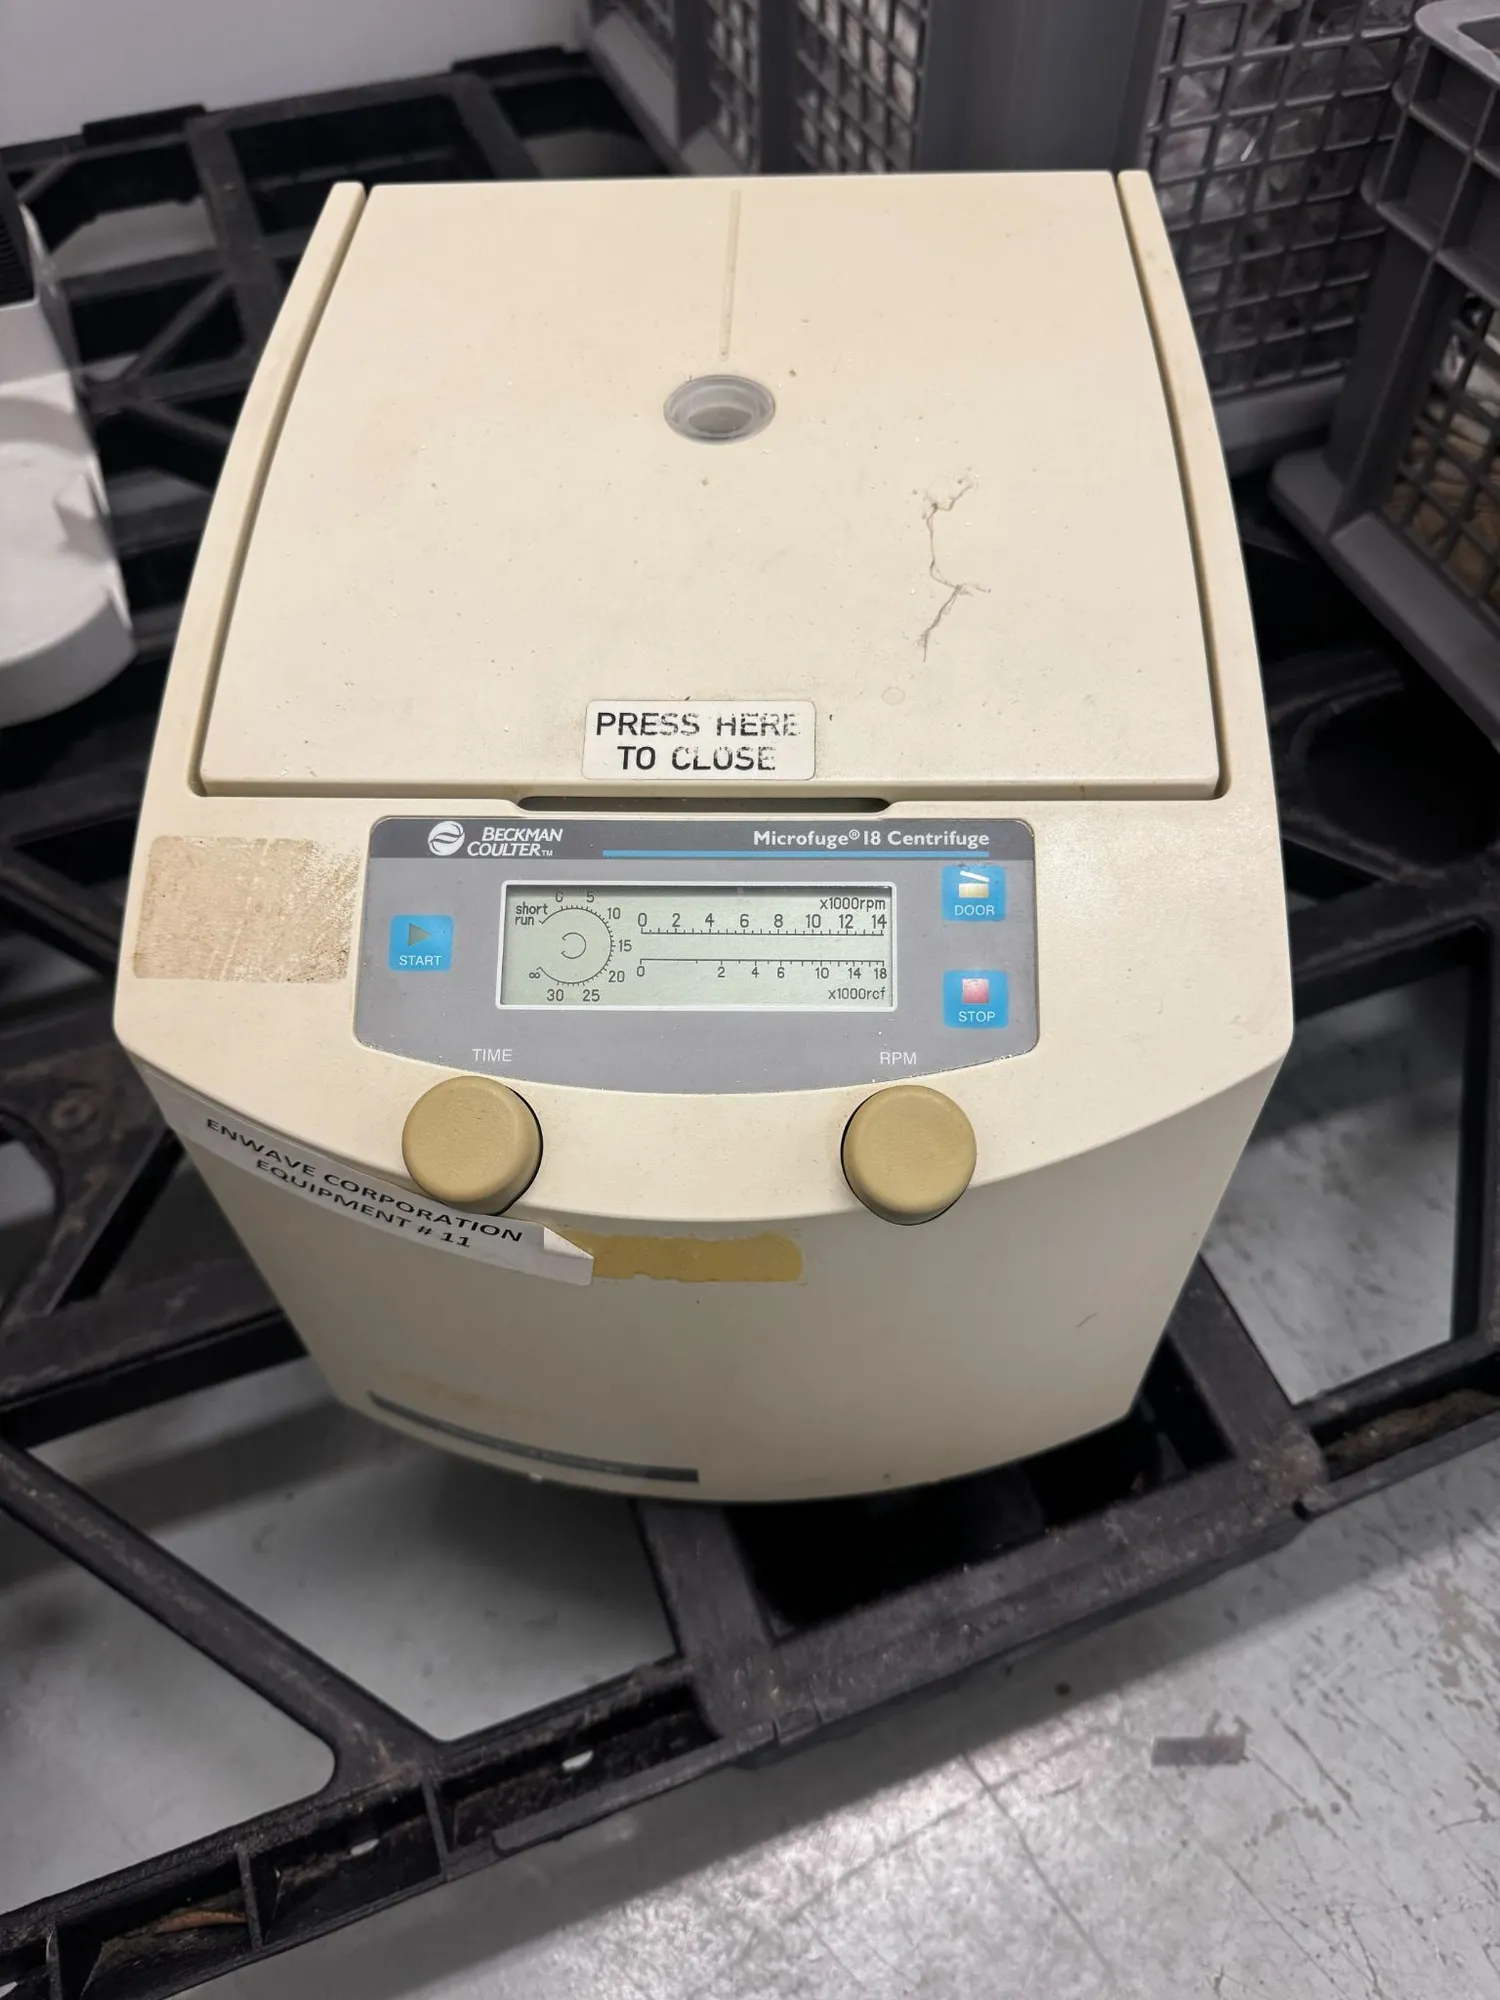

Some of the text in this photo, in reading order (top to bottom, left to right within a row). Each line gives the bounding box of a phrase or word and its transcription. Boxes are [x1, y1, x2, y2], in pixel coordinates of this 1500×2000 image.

[596, 712, 800, 738] PRESS HERE
[617, 745, 776, 772] TO CLOSE
[482, 827, 562, 842] BECKMAN
[887, 830, 989, 847] Centrifuge
[586, 891, 594, 903] 5
[516, 903, 548, 915] short
[820, 897, 886, 912] x1000rpm
[954, 904, 994, 916] DOOR
[608, 908, 621, 919] 10
[515, 916, 534, 926] run
[638, 914, 887, 928] 0 2 4 6 8 10 12 14
[619, 940, 632, 951] 15
[399, 953, 442, 966] START
[609, 971, 625, 983] 20
[636, 967, 887, 979] 0 2 4 6 10 14 18
[547, 990, 564, 1002] 30
[583, 990, 600, 1001] 25
[828, 987, 886, 1000] x1000rcf
[958, 1011, 995, 1023] STOP
[472, 1049, 512, 1062] TIME
[880, 1052, 916, 1065] RPM
[206, 1118, 522, 1243] ENWAVE CORPORATION
[256, 1158, 471, 1247] EQUIPMENT # 11
